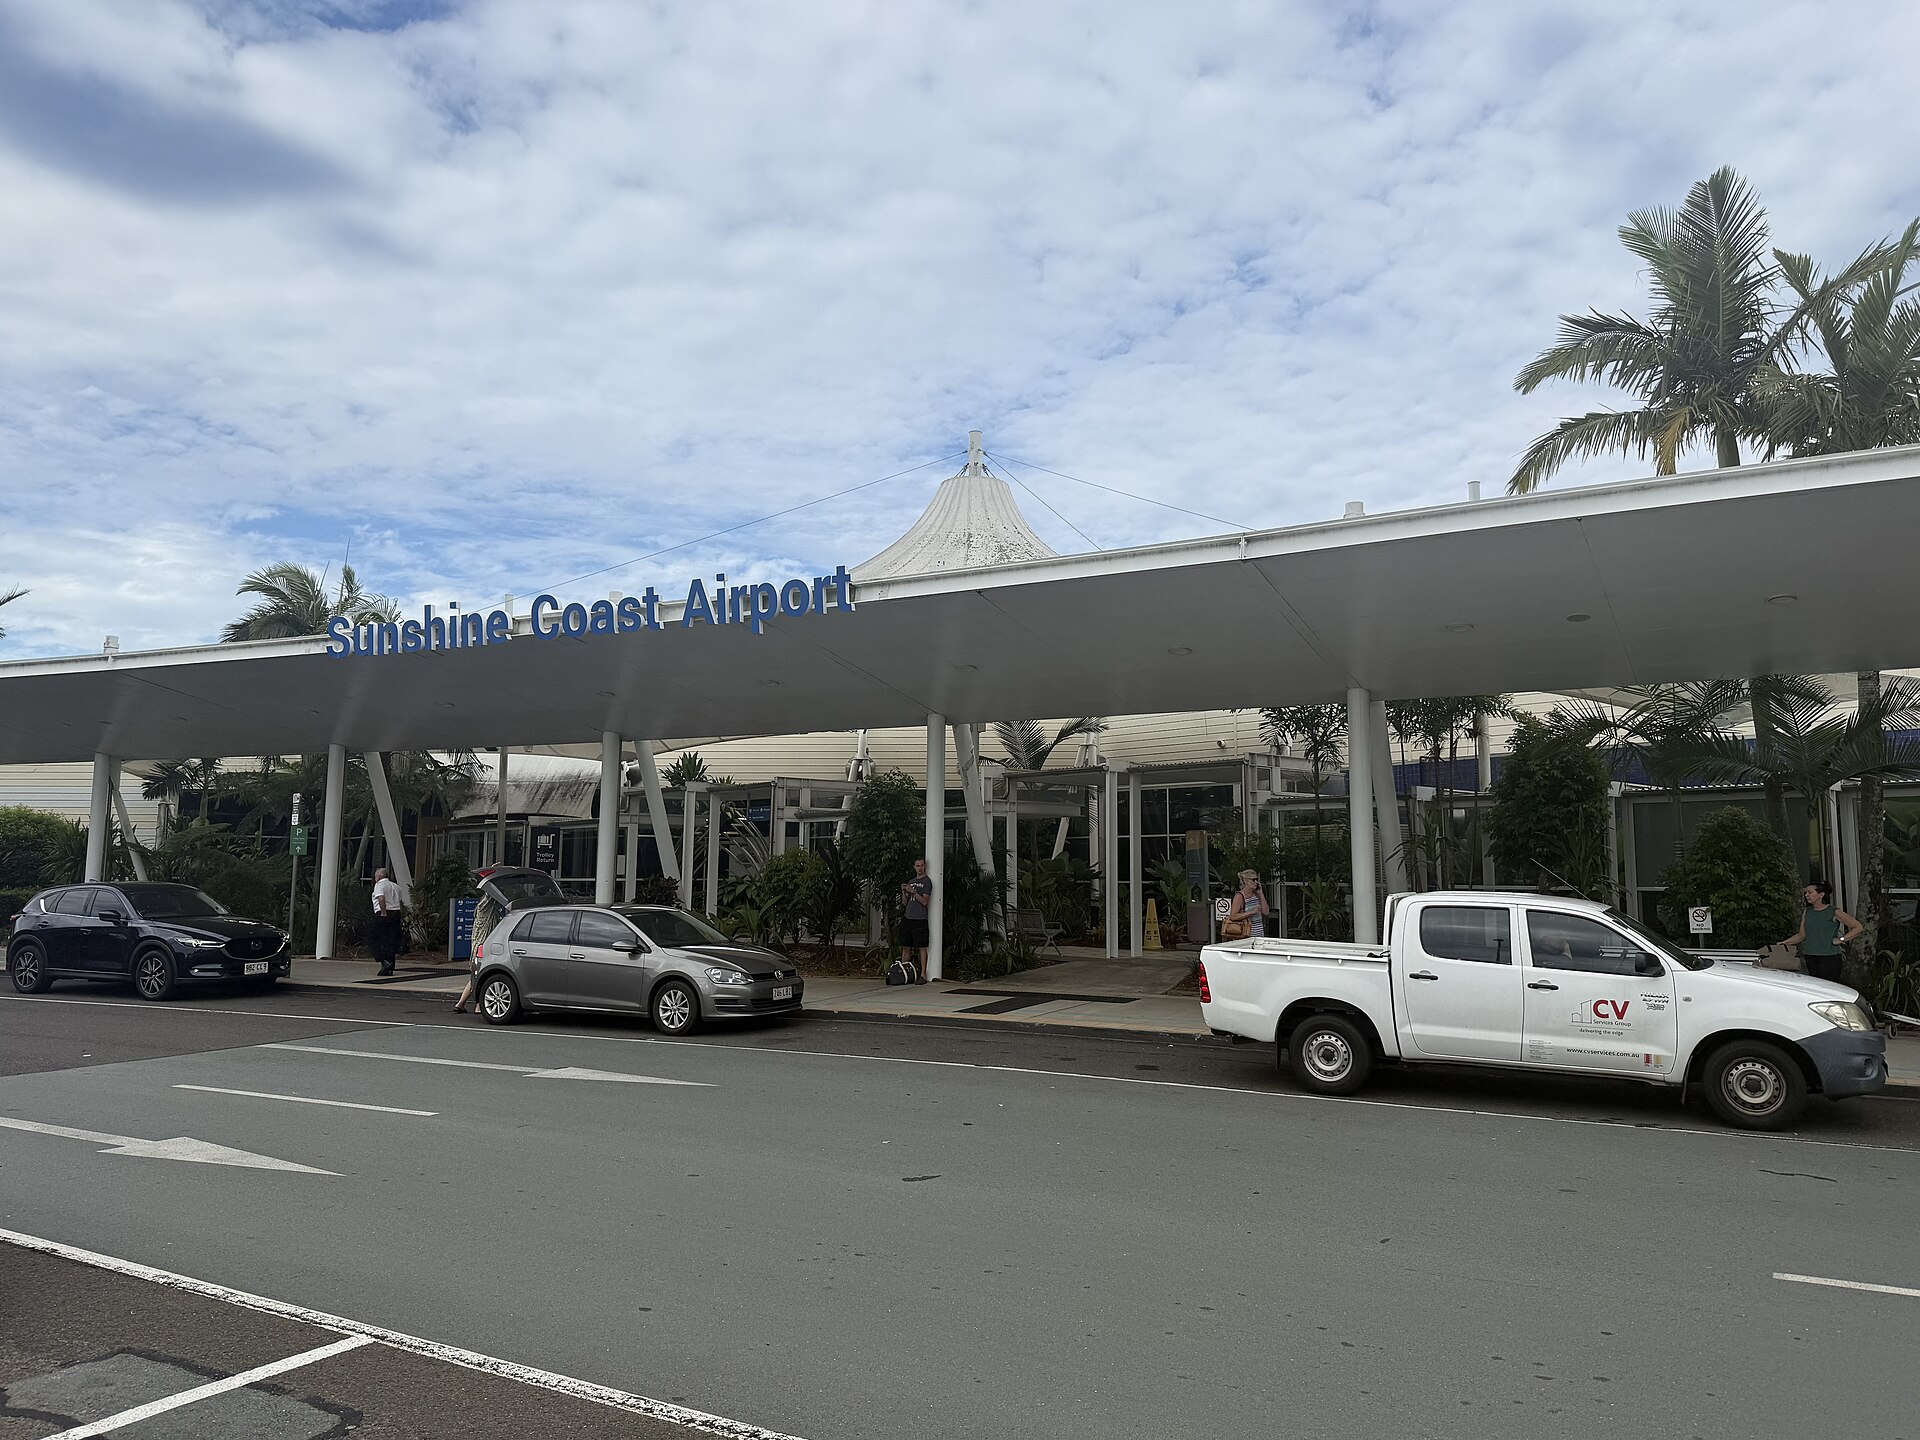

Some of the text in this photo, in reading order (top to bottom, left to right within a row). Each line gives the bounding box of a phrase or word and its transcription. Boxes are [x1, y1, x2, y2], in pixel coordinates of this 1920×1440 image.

[326, 565, 854, 660] Sunshine Coast Airport
[296, 827, 303, 836] P
[1592, 999, 1630, 1020] CV
[1566, 1048, 1640, 1058] www.cvservices.com.au
